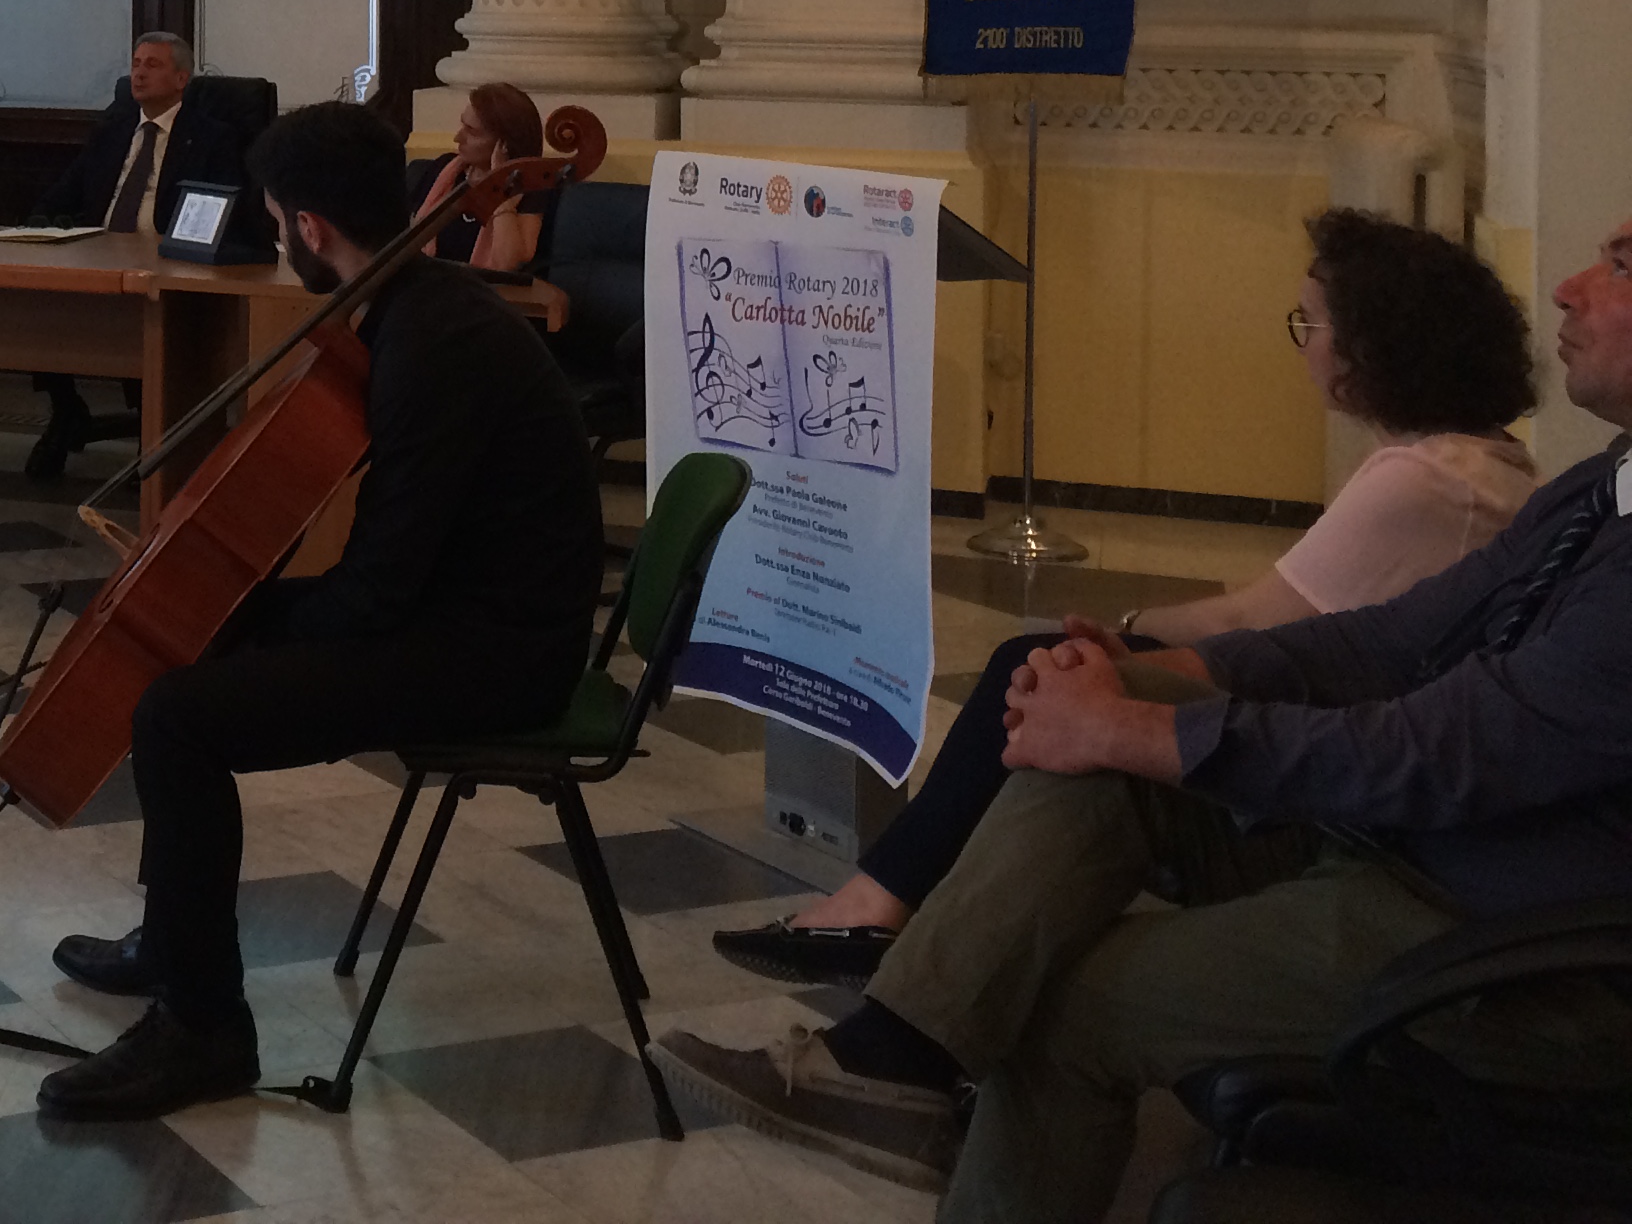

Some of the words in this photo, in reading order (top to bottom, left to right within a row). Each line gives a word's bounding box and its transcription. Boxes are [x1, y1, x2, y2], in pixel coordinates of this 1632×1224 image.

[1014, 26, 1084, 49] DISTRETTO
[719, 177, 763, 204] Rotary
[863, 184, 897, 198] Rotaract
[785, 272, 836, 300] Rotary
[841, 276, 879, 297] 2018
[786, 485, 810, 501] Paola
[811, 493, 848, 511] Galeone
[772, 509, 811, 528] Giovanni
[774, 663, 786, 677] 12
